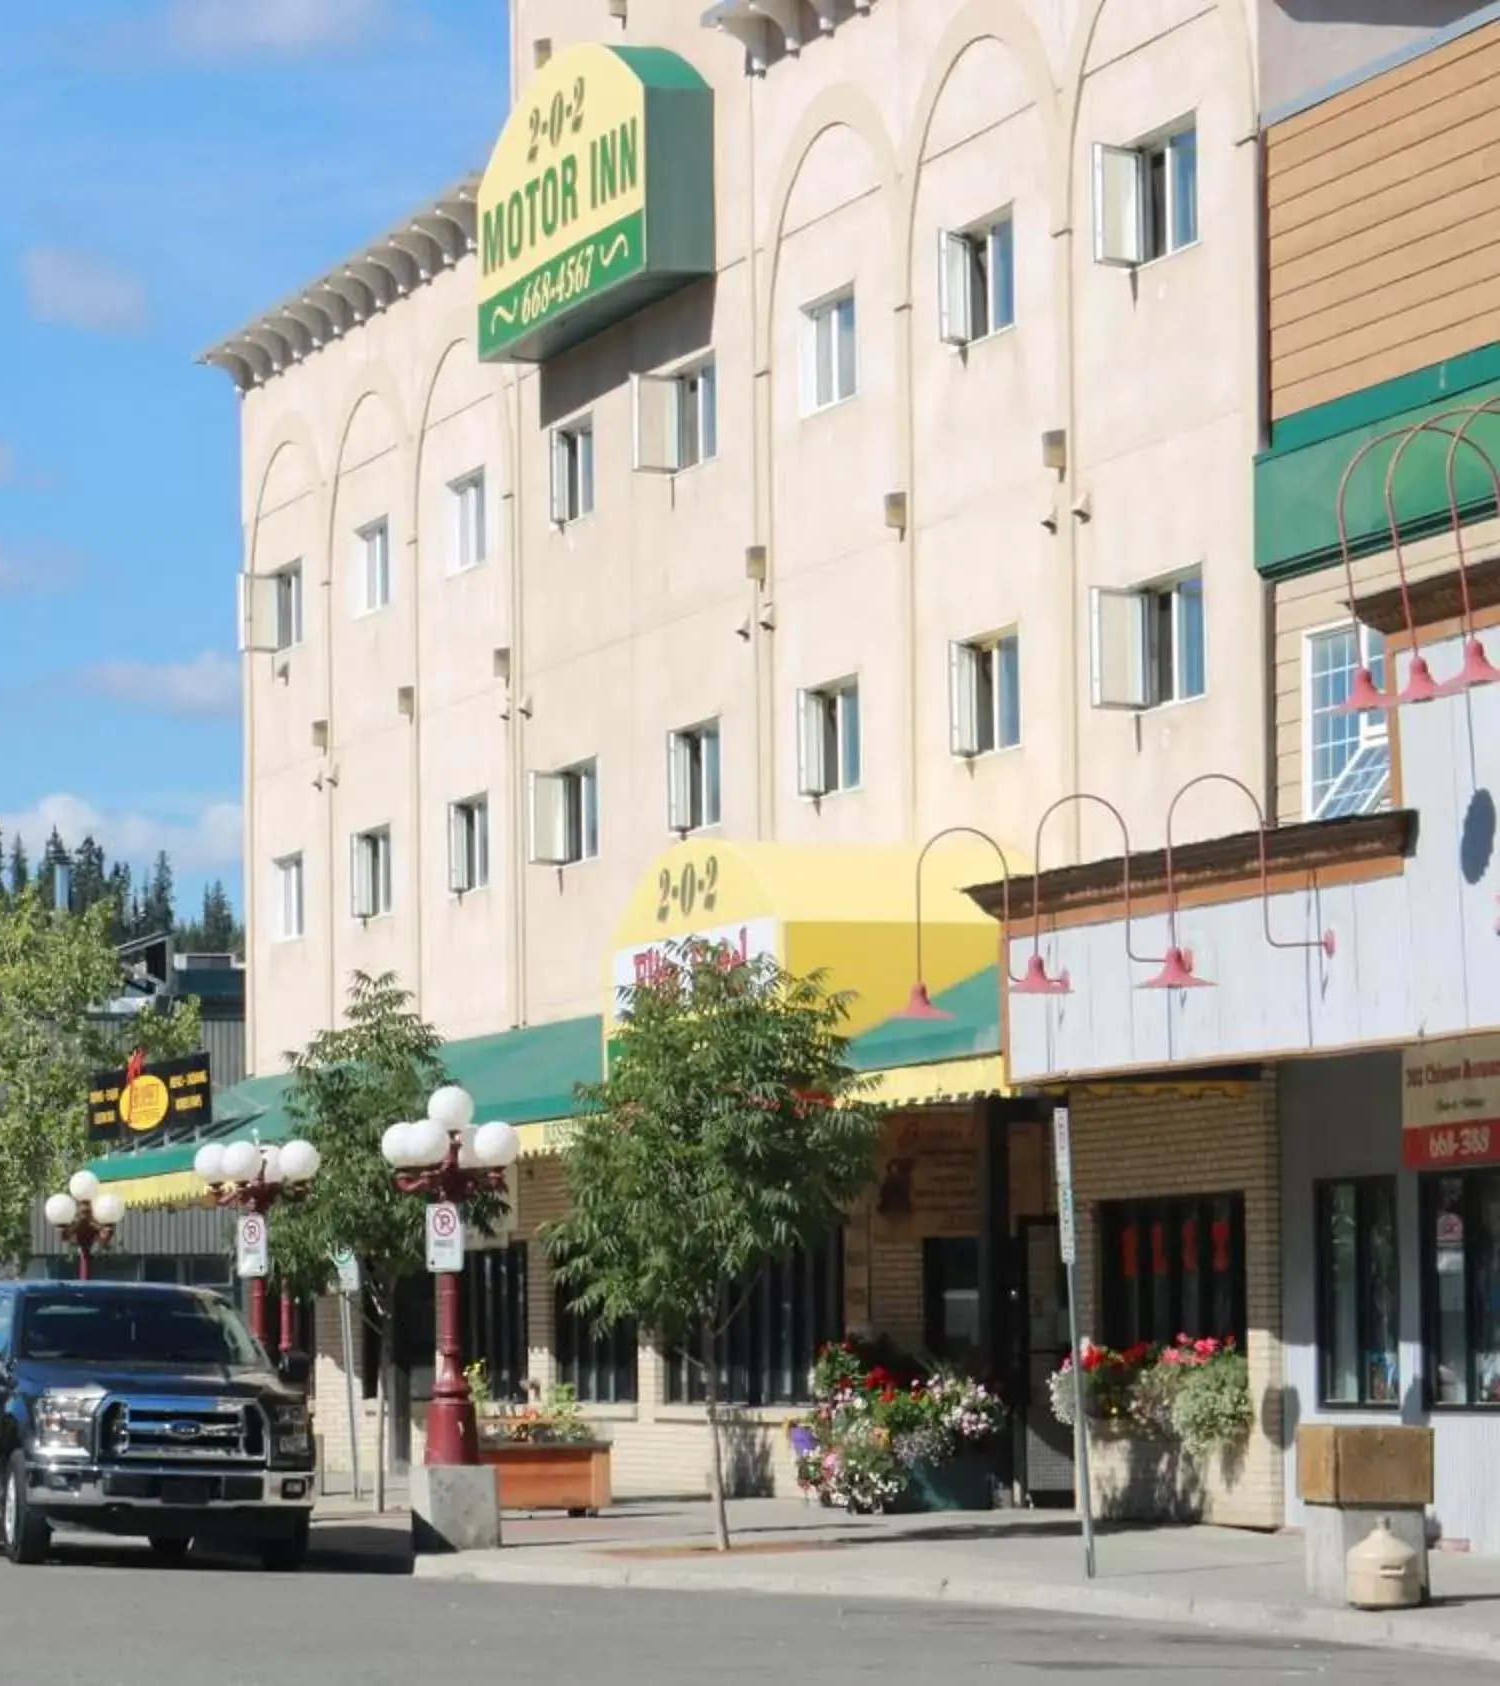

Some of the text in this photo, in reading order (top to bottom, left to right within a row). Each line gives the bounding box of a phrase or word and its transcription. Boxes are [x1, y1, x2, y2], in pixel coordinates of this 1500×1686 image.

[482, 116, 638, 278] MOTOR INN
[520, 244, 595, 325] 668-4567
